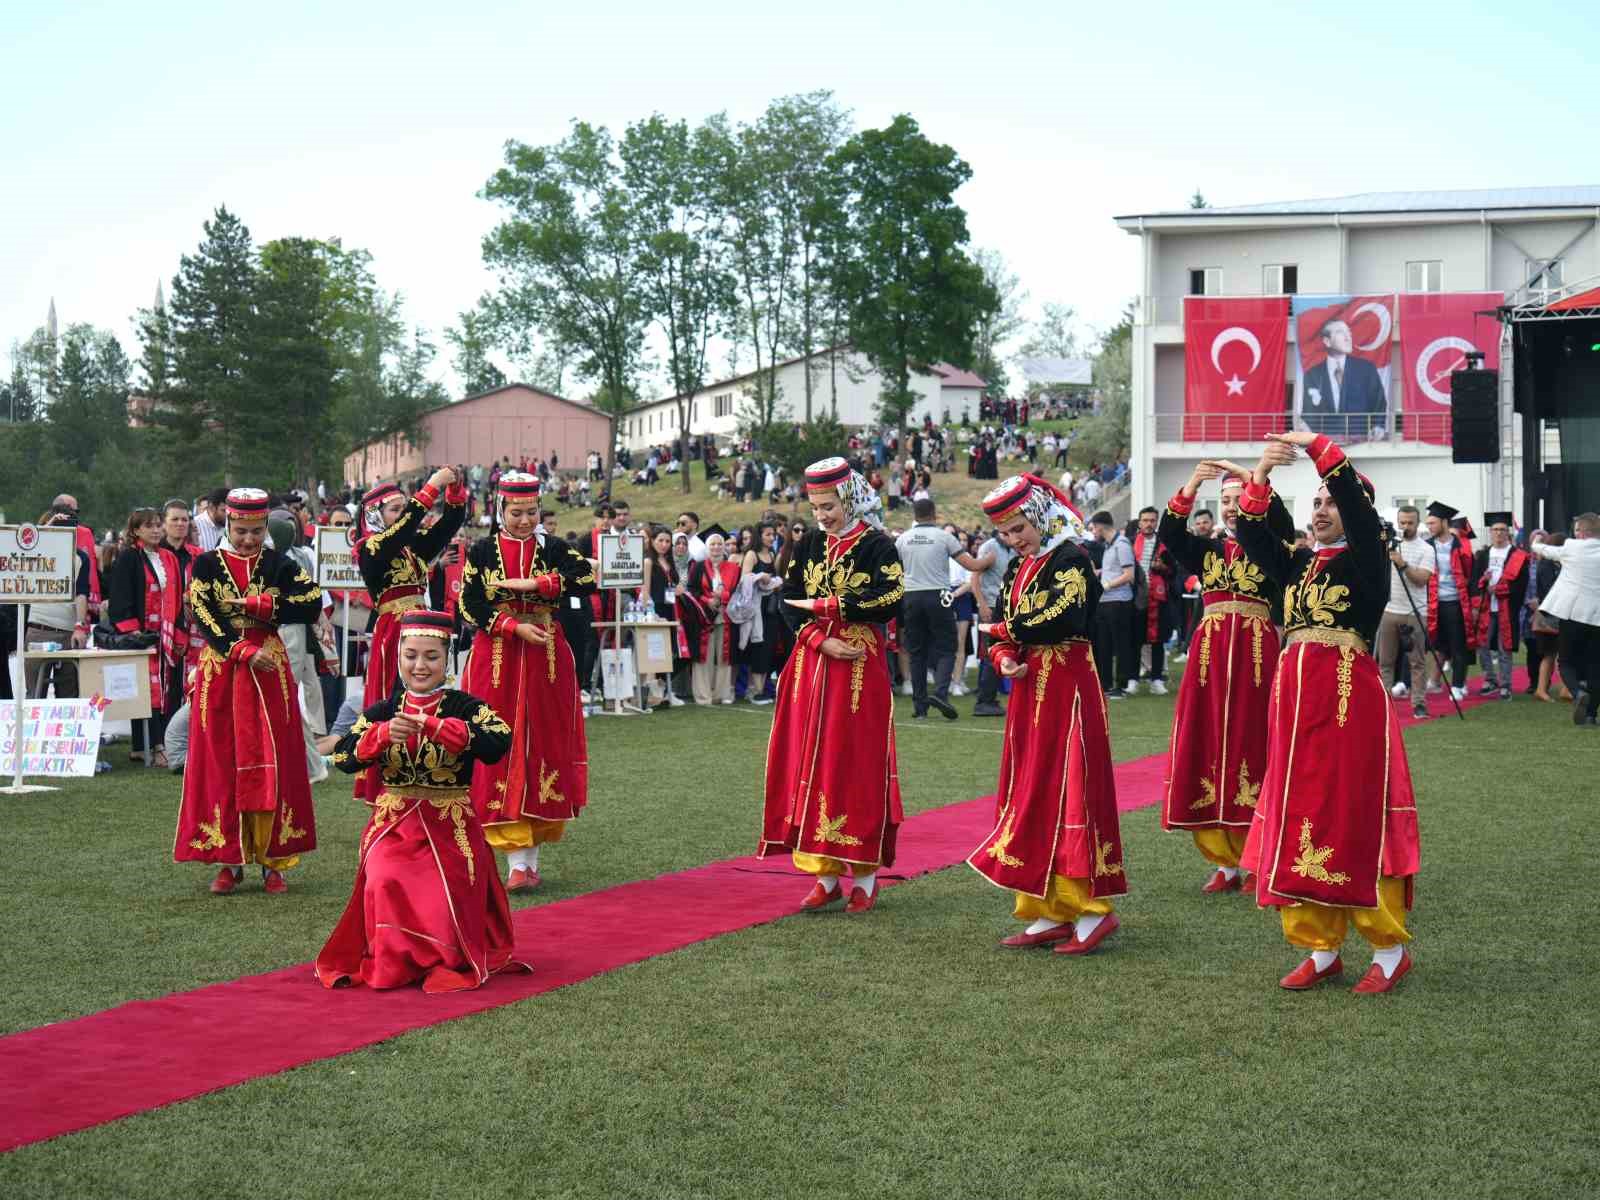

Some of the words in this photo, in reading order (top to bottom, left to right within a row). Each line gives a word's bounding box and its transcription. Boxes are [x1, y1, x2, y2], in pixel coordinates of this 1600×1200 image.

[0, 552, 56, 572] EĞİTİM
[0, 575, 71, 594] KÜLTESİ
[6, 720, 40, 737] YNİ
[45, 721, 85, 737] NESİL
[2, 739, 38, 754] SİİN
[41, 739, 96, 755] ESERİNİZ
